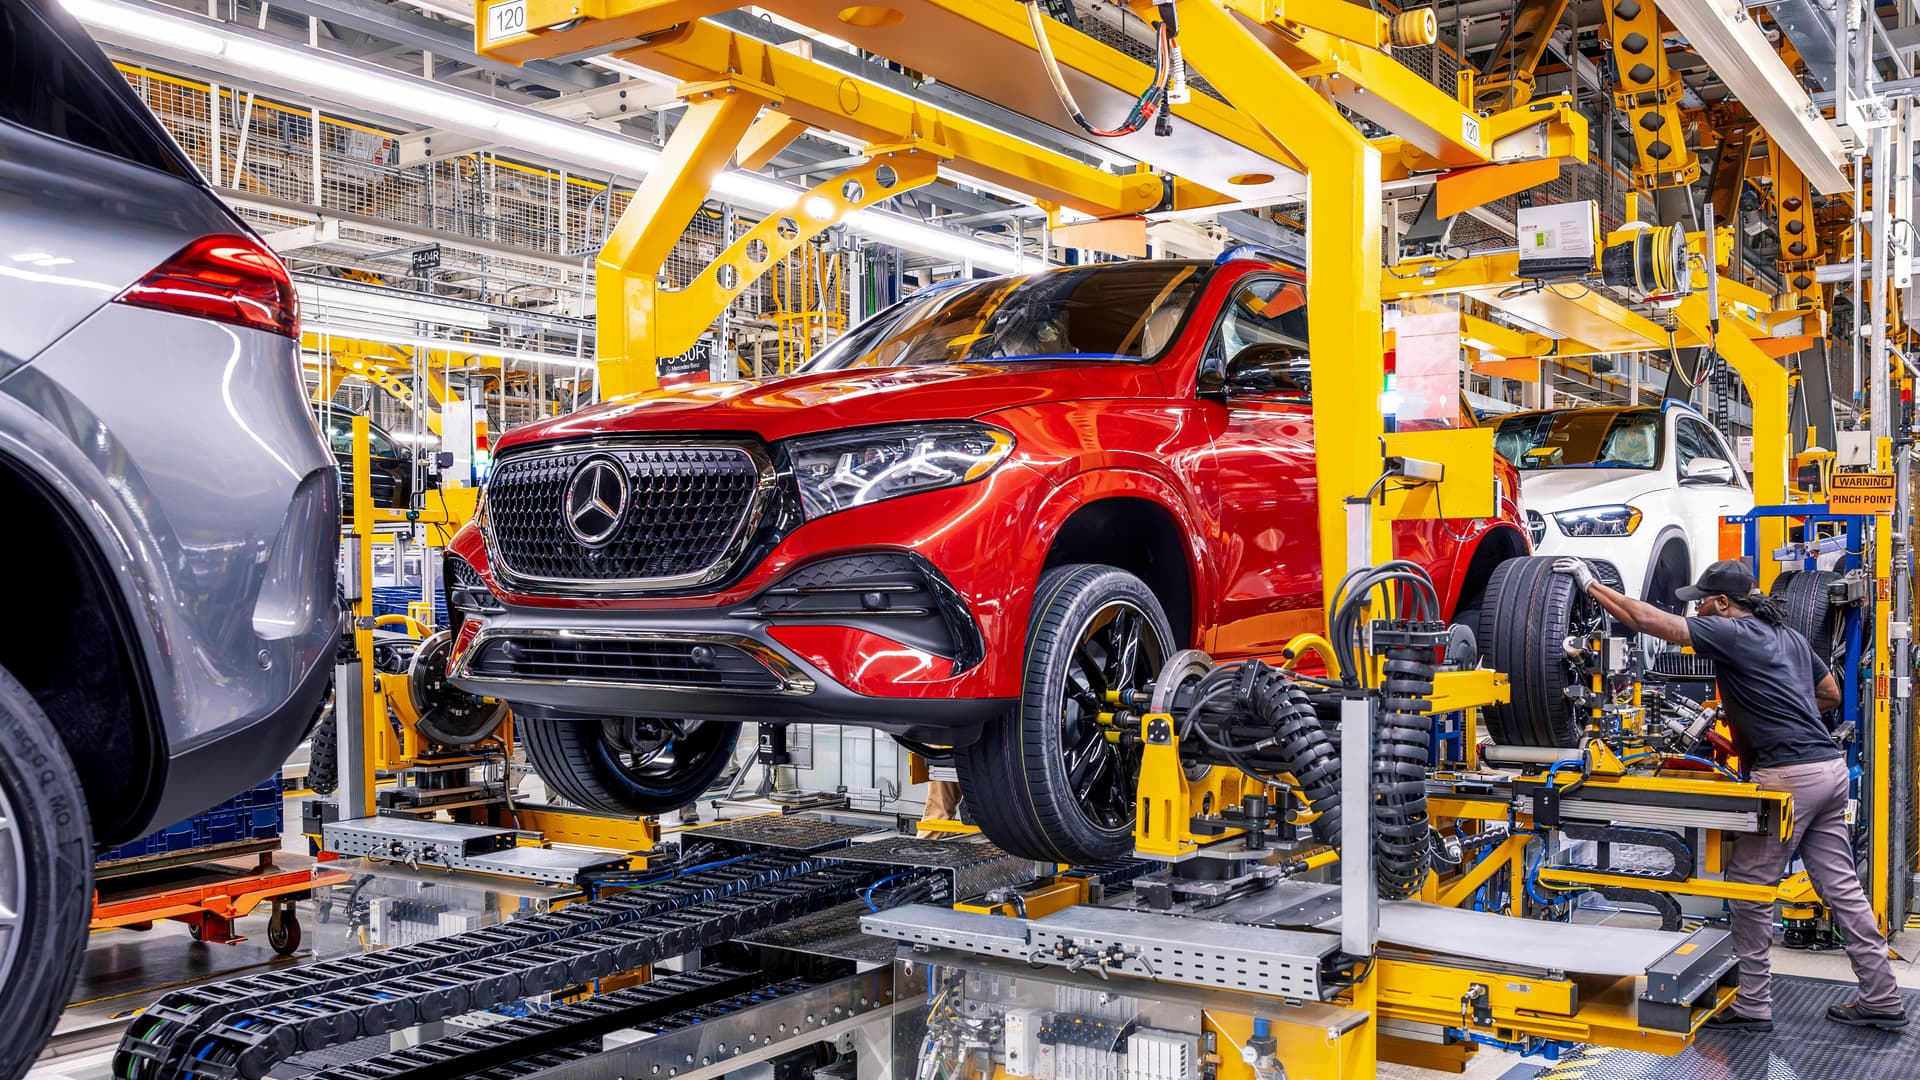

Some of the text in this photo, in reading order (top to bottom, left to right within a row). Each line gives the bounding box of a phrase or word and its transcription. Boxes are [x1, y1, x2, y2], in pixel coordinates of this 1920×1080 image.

[497, 6, 524, 32] 120
[1466, 120, 1477, 142] 120
[413, 250, 440, 265] F4-04R
[1839, 477, 1888, 486] WARNING
[1832, 495, 1893, 504] PINCH POINT
[48, 794, 71, 826] MO
